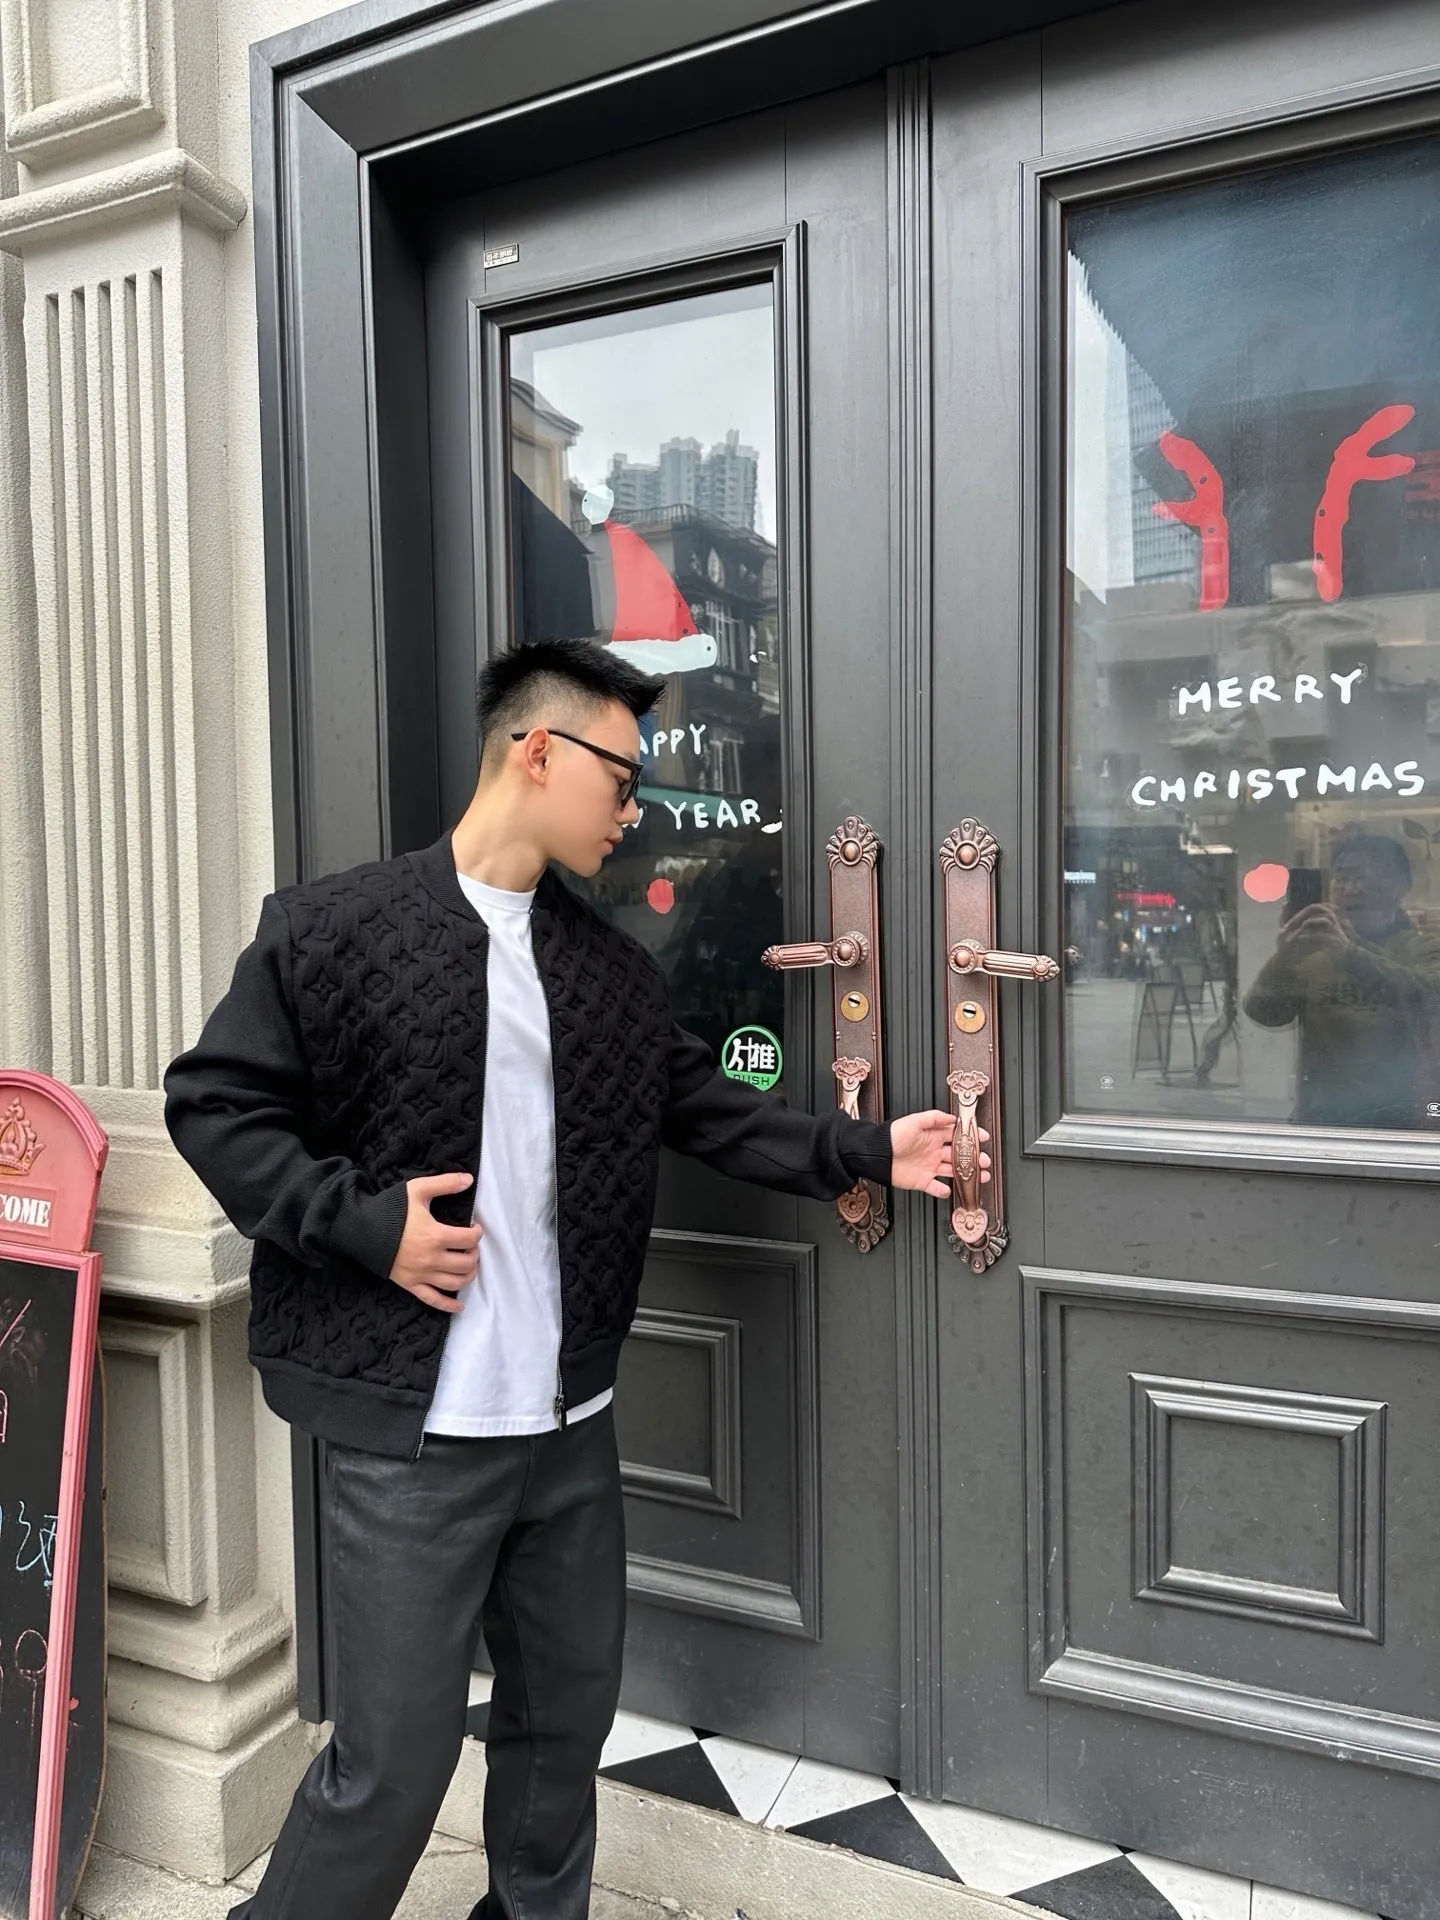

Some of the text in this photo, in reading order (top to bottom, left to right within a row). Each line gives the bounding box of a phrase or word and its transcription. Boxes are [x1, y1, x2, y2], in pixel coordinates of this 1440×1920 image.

[1178, 668, 1362, 715] MERRY
[1131, 760, 1425, 806] CHRISTMAS
[664, 798, 761, 831] YEAR
